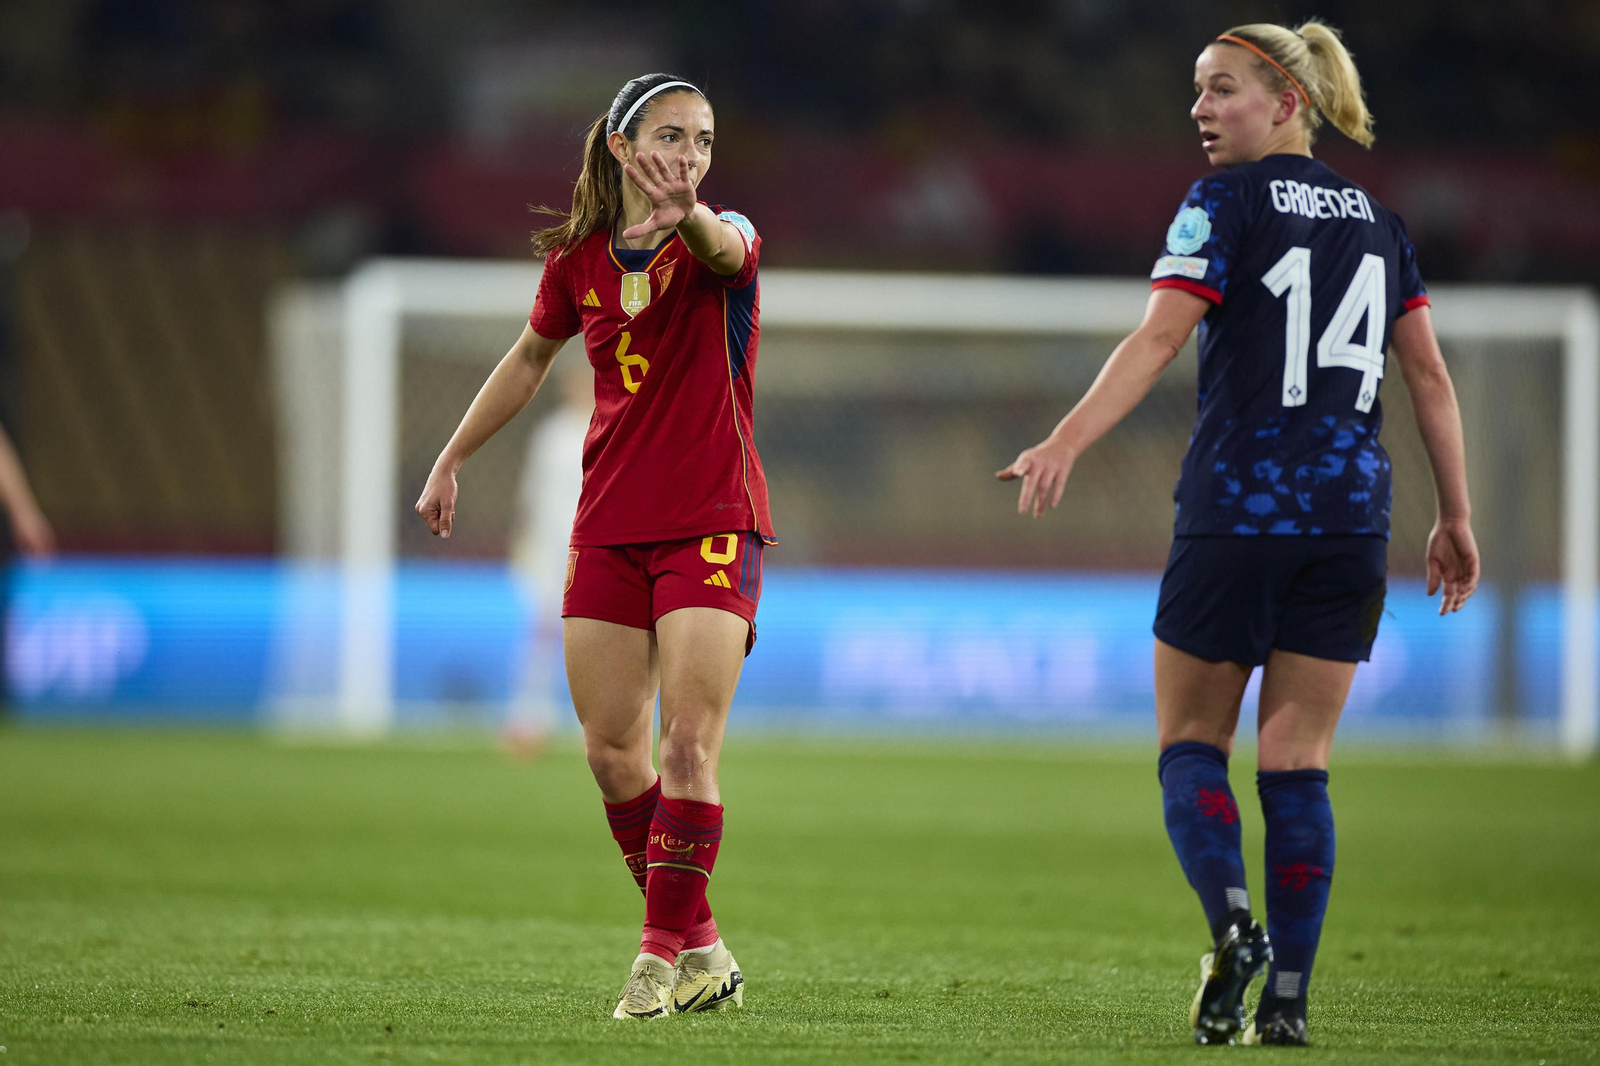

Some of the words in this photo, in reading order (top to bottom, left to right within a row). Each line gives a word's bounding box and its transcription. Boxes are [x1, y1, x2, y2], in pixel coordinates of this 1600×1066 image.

[1268, 179, 1376, 223] GROENEN
[1260, 246, 1386, 414] 14
[615, 331, 650, 394] 6
